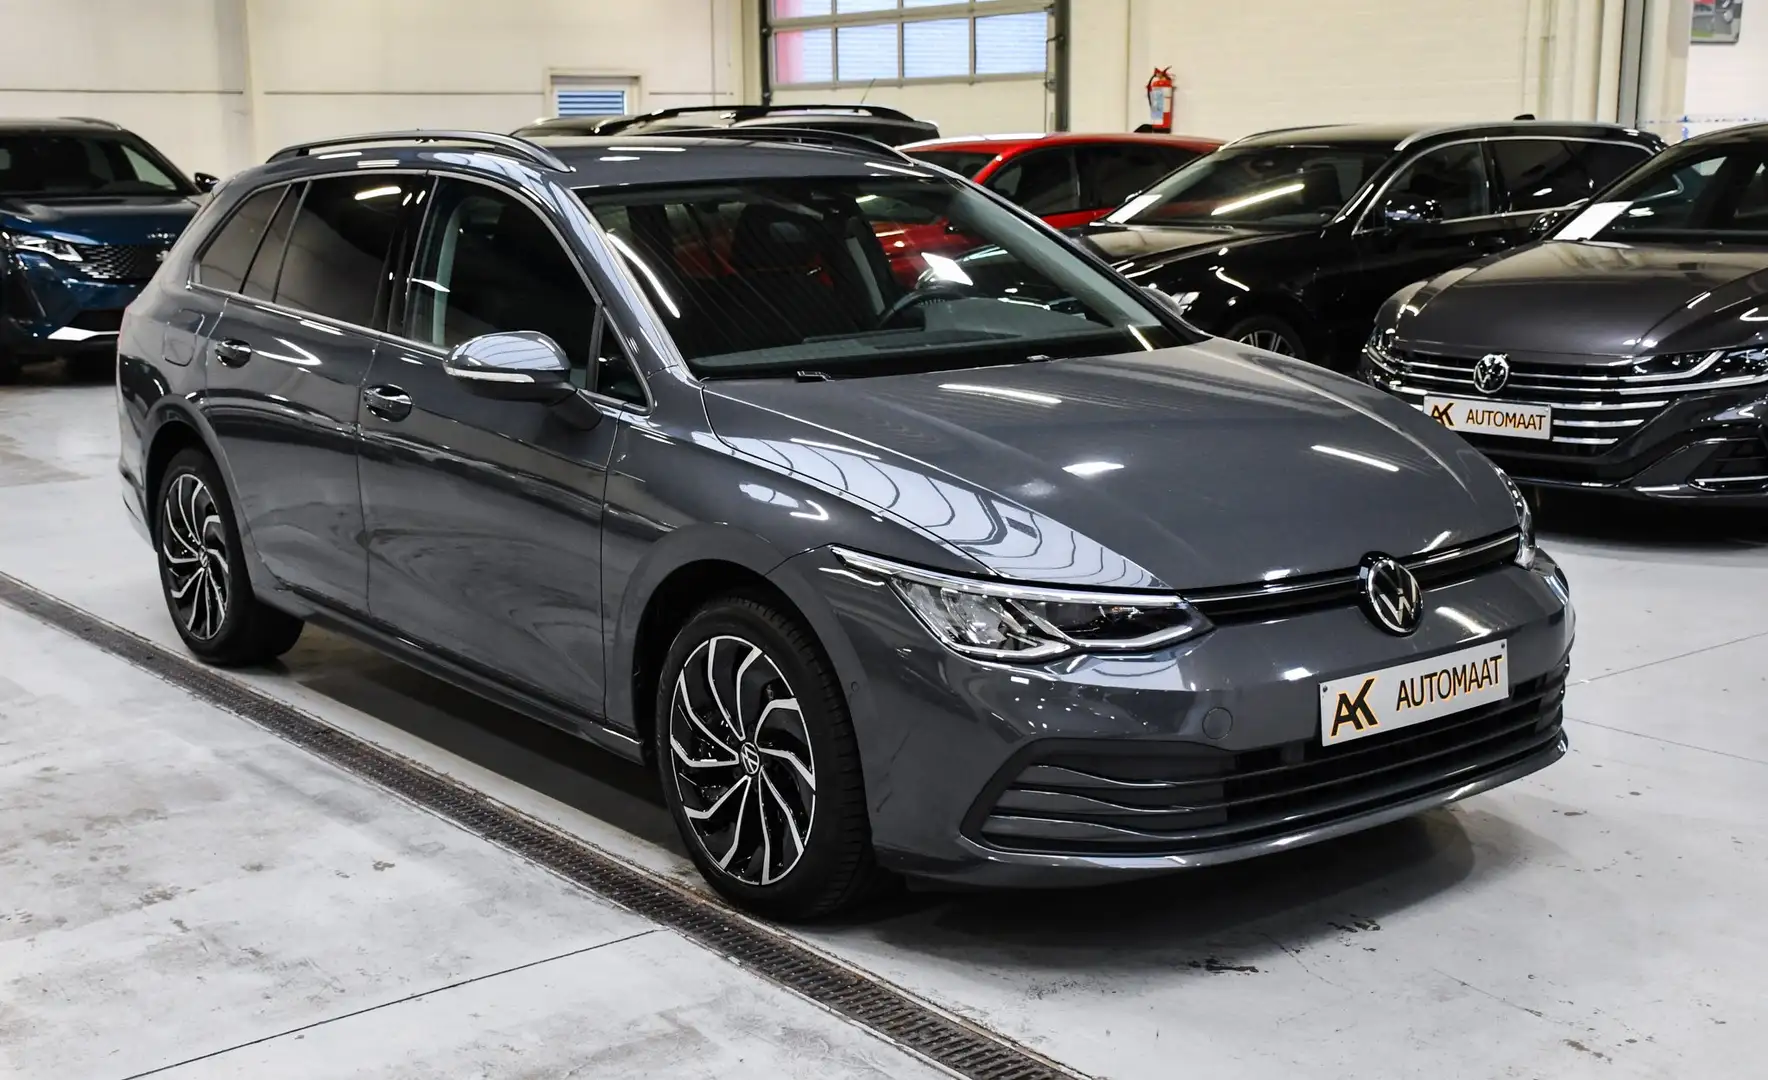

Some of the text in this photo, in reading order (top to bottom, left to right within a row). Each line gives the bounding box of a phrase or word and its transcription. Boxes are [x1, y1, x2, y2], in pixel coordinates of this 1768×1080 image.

[1465, 408, 1547, 431] AUTOMAAT
[1330, 654, 1503, 737] AK AUTOMAAT
